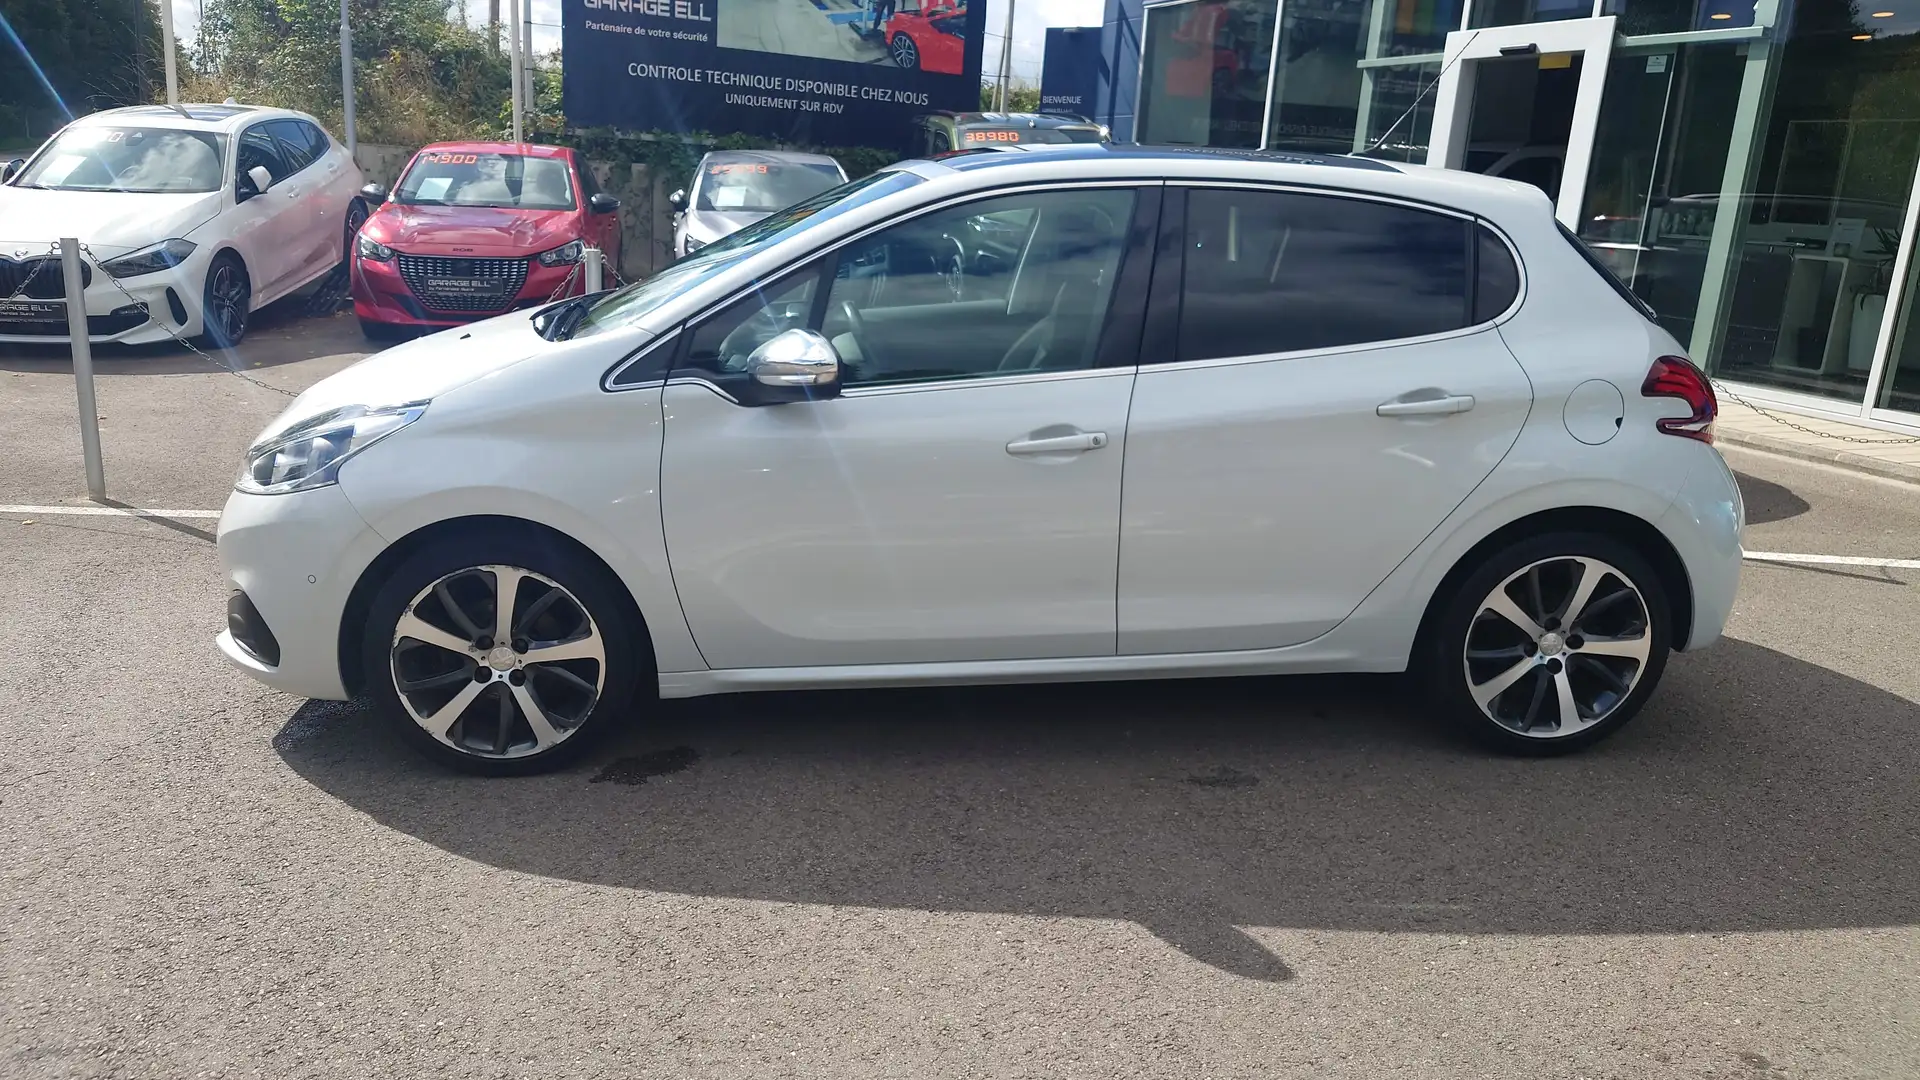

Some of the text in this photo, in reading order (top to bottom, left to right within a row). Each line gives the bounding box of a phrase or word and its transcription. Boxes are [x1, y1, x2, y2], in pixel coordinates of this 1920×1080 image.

[674, 1, 712, 22] ELL
[585, 20, 708, 42] Partenaire de votre sécurité
[628, 63, 929, 106] CONTROLE TECHNIQUE DISPONIBLE CHEZ NOUS
[725, 93, 844, 114] UNIQUEMENT SUR RDV
[1042, 95, 1082, 104] BIENVENUE
[965, 132, 1019, 142] 38980
[422, 155, 477, 164] 14900
